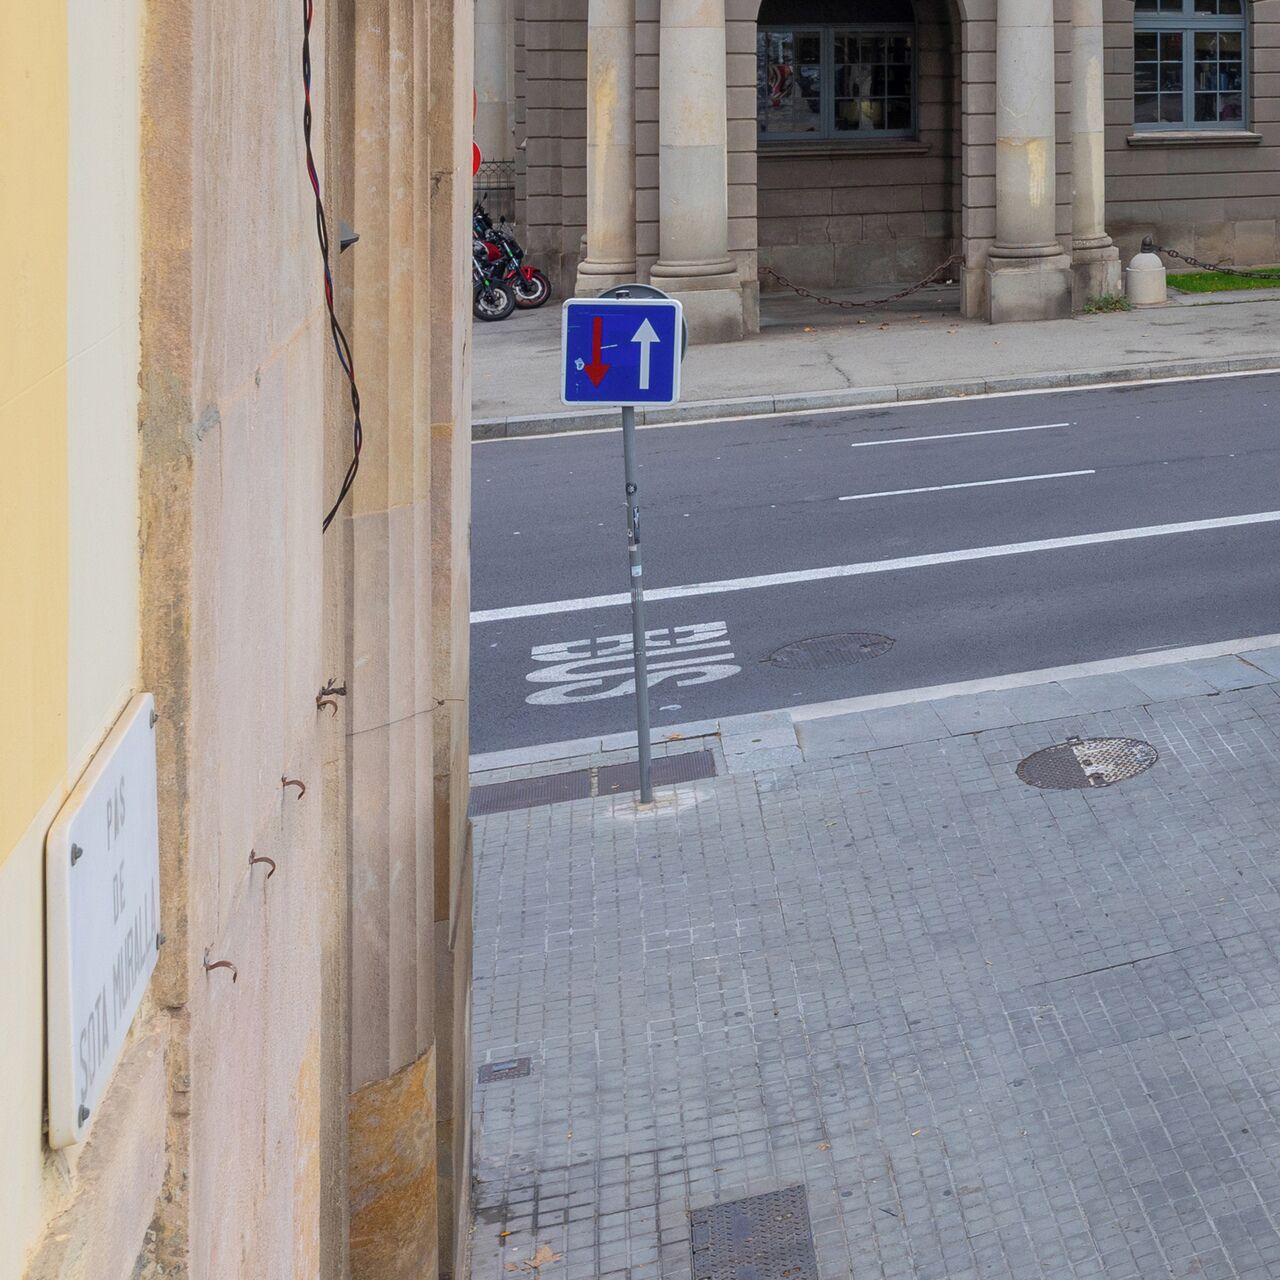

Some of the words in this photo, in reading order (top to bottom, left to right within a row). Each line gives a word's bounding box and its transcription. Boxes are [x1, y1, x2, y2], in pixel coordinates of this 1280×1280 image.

[525, 621, 741, 705] BUS
[106, 775, 125, 852] PAS
[112, 859, 125, 926] DE
[79, 984, 109, 1104] SOTA
[112, 876, 156, 1031] MURALLA
